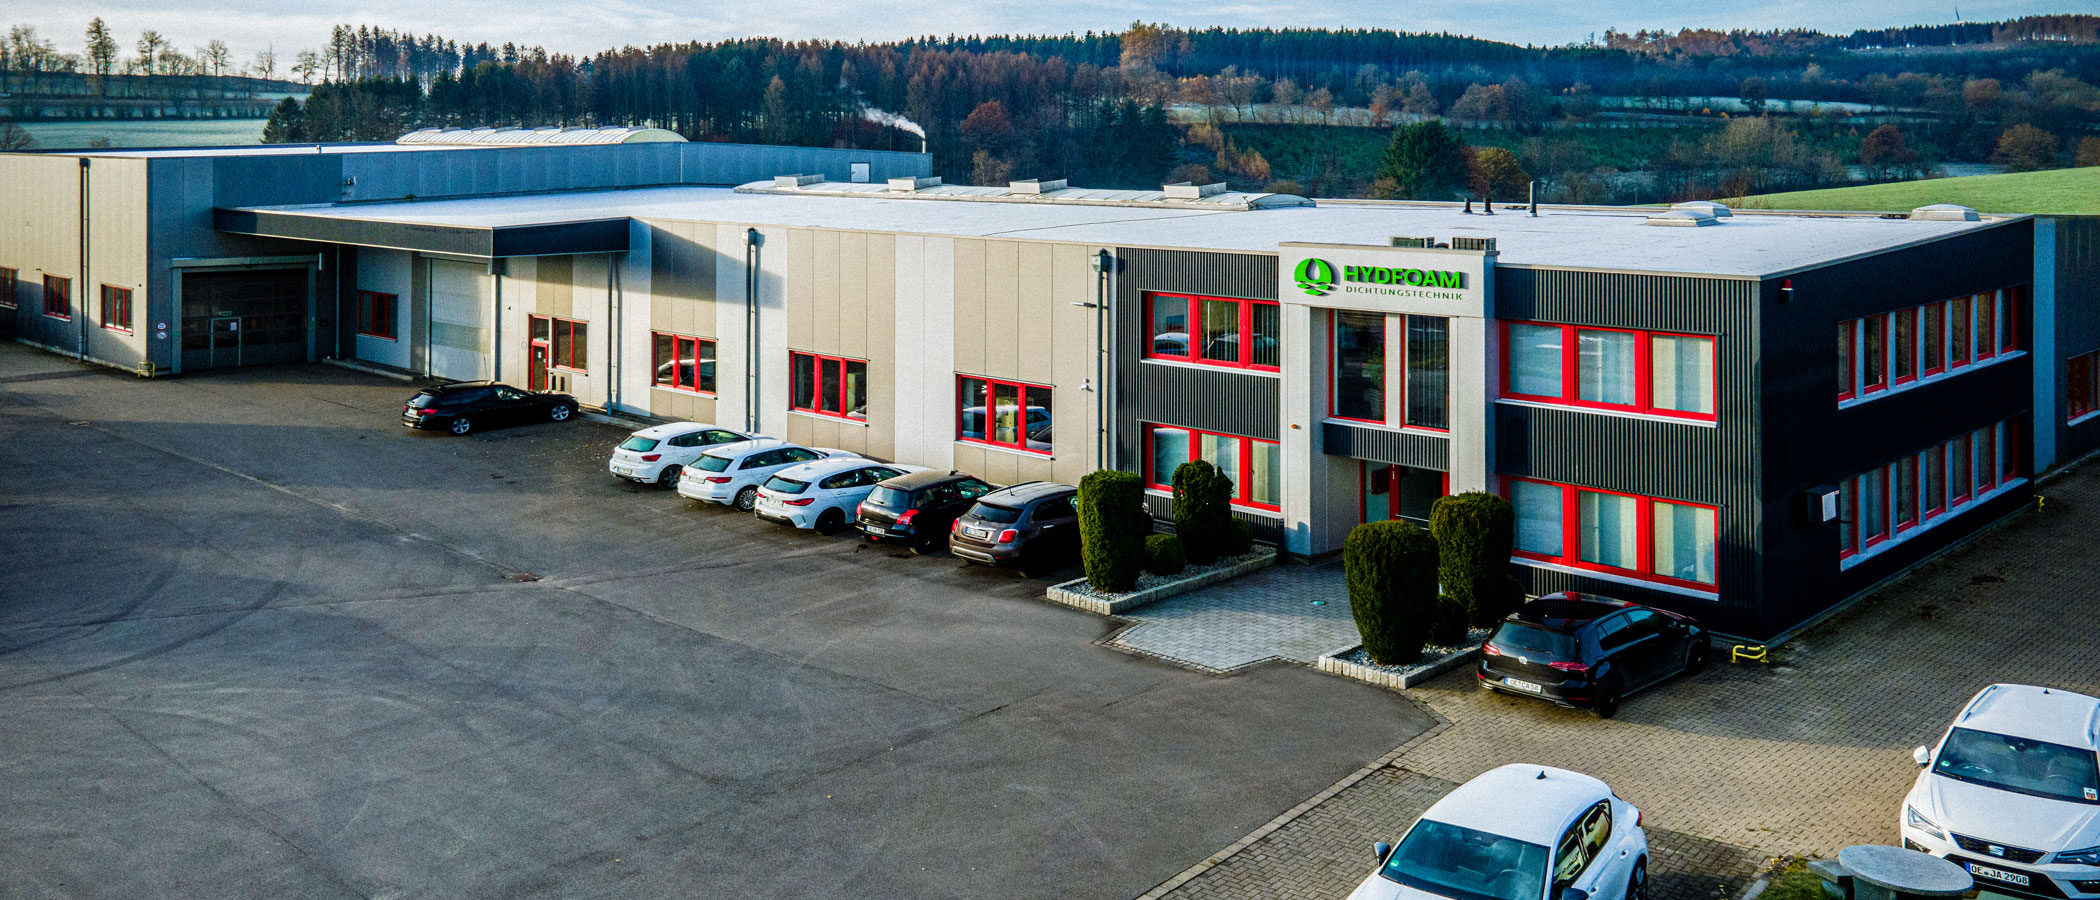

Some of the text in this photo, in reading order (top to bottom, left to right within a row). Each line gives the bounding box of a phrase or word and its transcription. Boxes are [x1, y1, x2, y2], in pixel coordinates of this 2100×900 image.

[1344, 265, 1461, 289] HYDFOAM
[1346, 286, 1463, 300] DICHTUNGSTECHNIK
[1971, 865, 2028, 884] OE JA 2908
